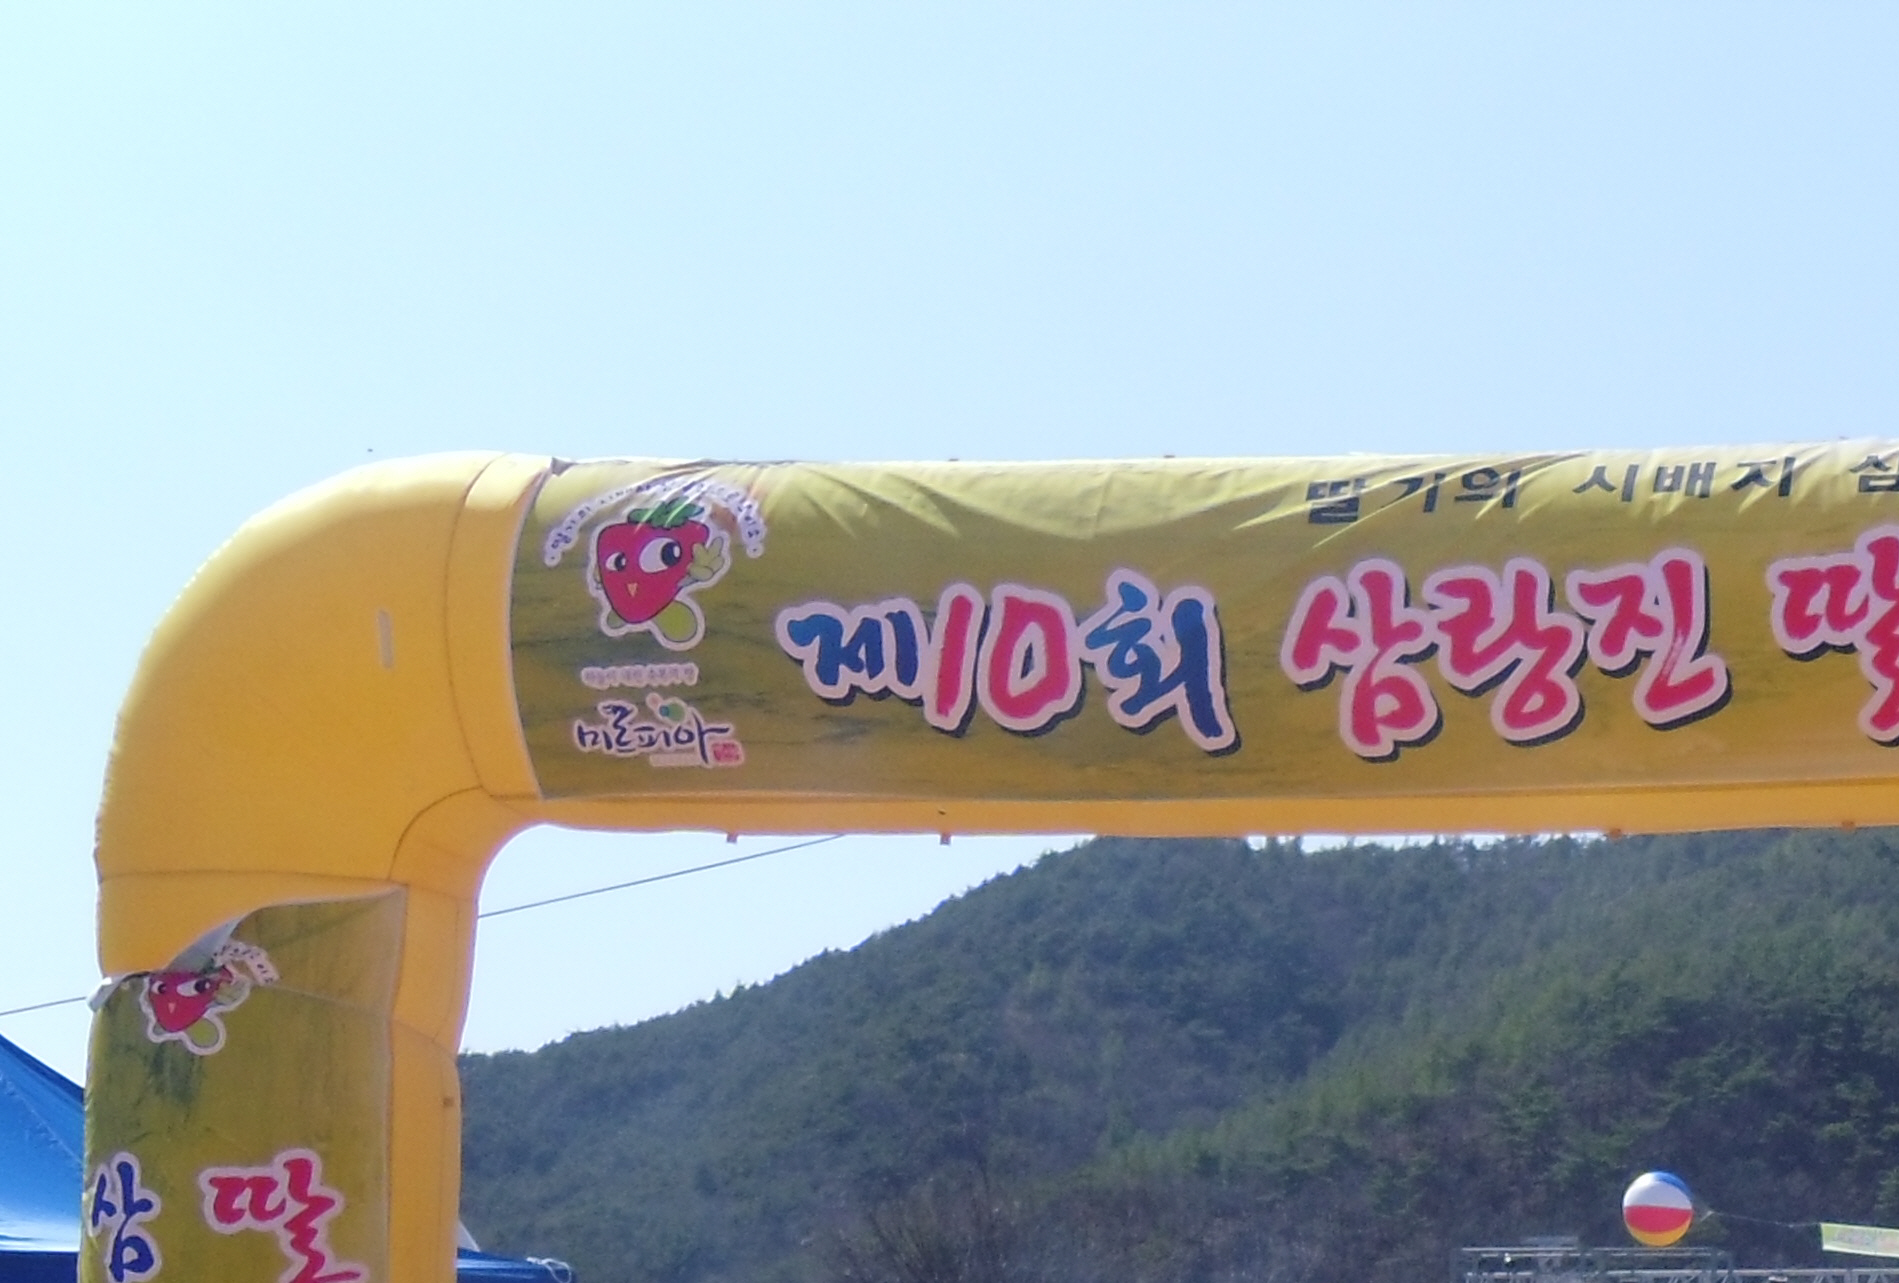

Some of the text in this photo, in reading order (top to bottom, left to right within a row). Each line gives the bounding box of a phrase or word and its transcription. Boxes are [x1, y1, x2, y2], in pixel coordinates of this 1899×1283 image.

[1305, 464, 1521, 524] 딸기의
[1571, 455, 1797, 503] 시배지
[780, 572, 1236, 752] 제10회
[1284, 552, 1722, 752] 삼랑진
